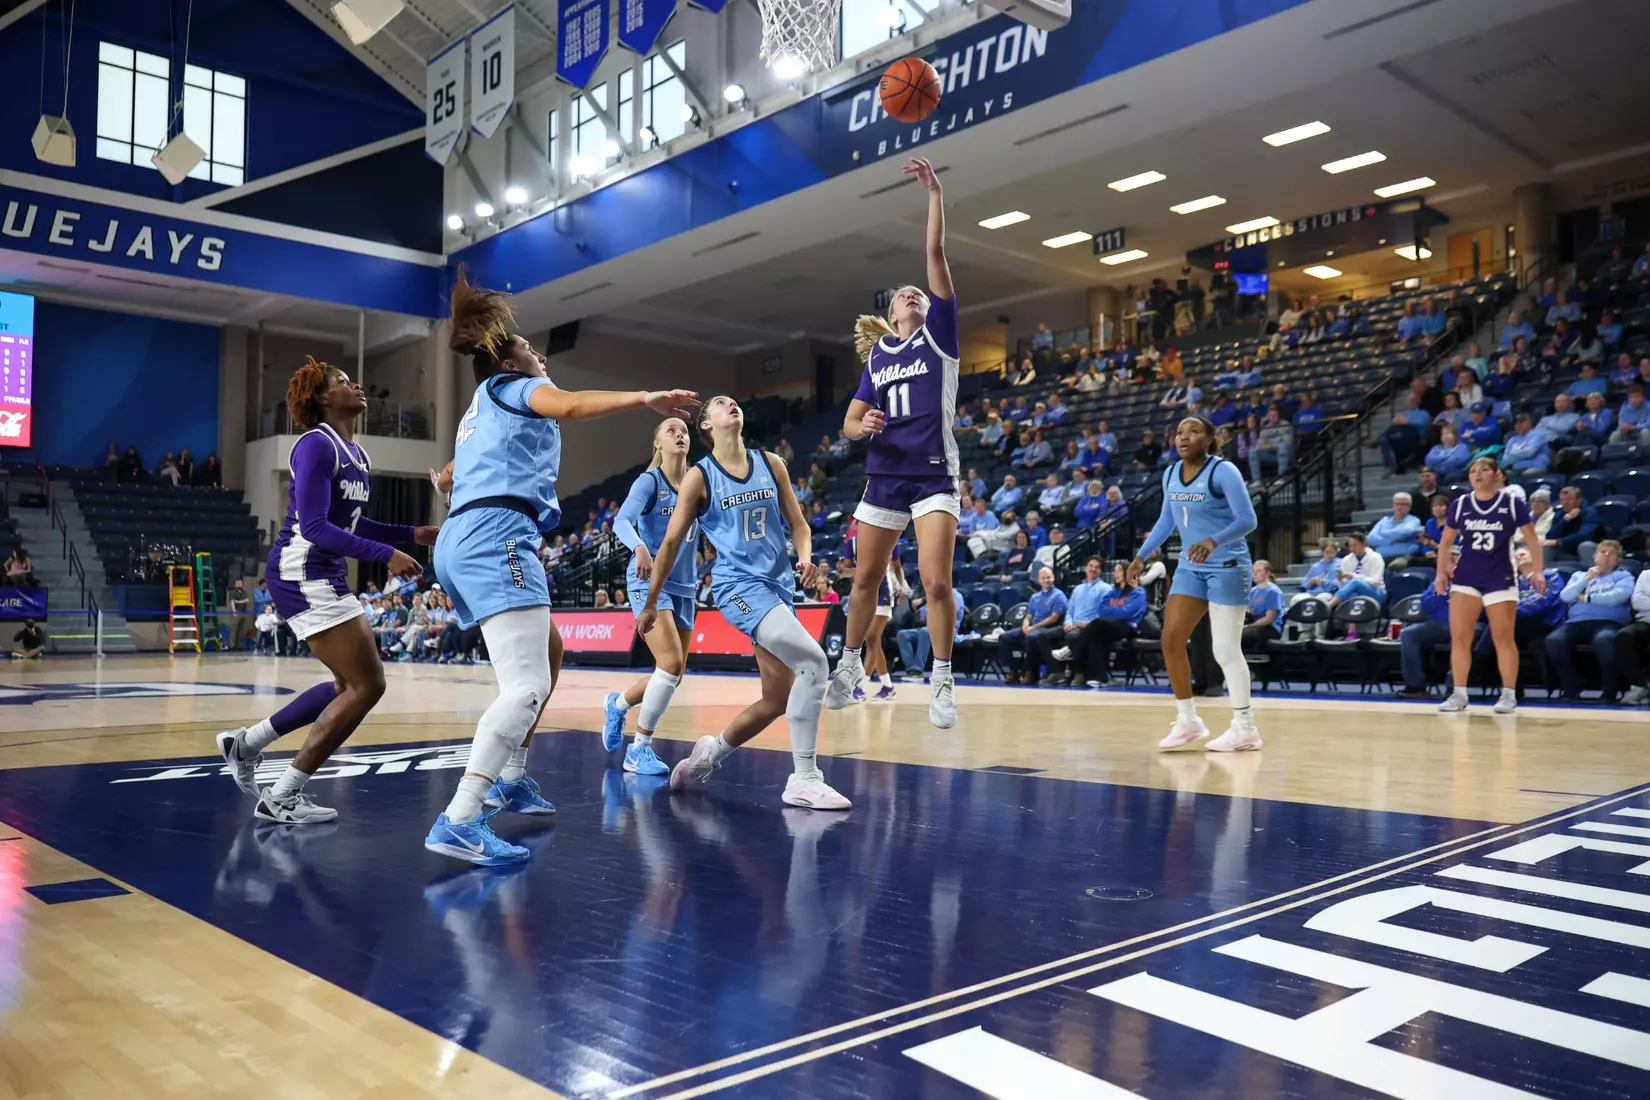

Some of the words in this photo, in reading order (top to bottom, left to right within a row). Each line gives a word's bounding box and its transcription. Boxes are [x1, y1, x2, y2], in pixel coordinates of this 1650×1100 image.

[482, 51, 501, 95] 10
[848, 24, 1048, 131] CGHTON
[433, 80, 456, 125] 25
[877, 92, 1012, 155] BLUEJAYS
[1096, 230, 1121, 252] 111
[1223, 207, 1361, 252] CONCESSIONS
[871, 357, 929, 391] Wildcats
[887, 382, 911, 419] 11
[720, 488, 776, 510] CREIGHTON
[1182, 505, 1189, 529] 1
[742, 506, 768, 543] 13
[1464, 519, 1504, 531] Wildcats
[1471, 531, 1495, 551] 23
[505, 539, 525, 588] BLUEJAYS
[575, 624, 616, 640] WORK
